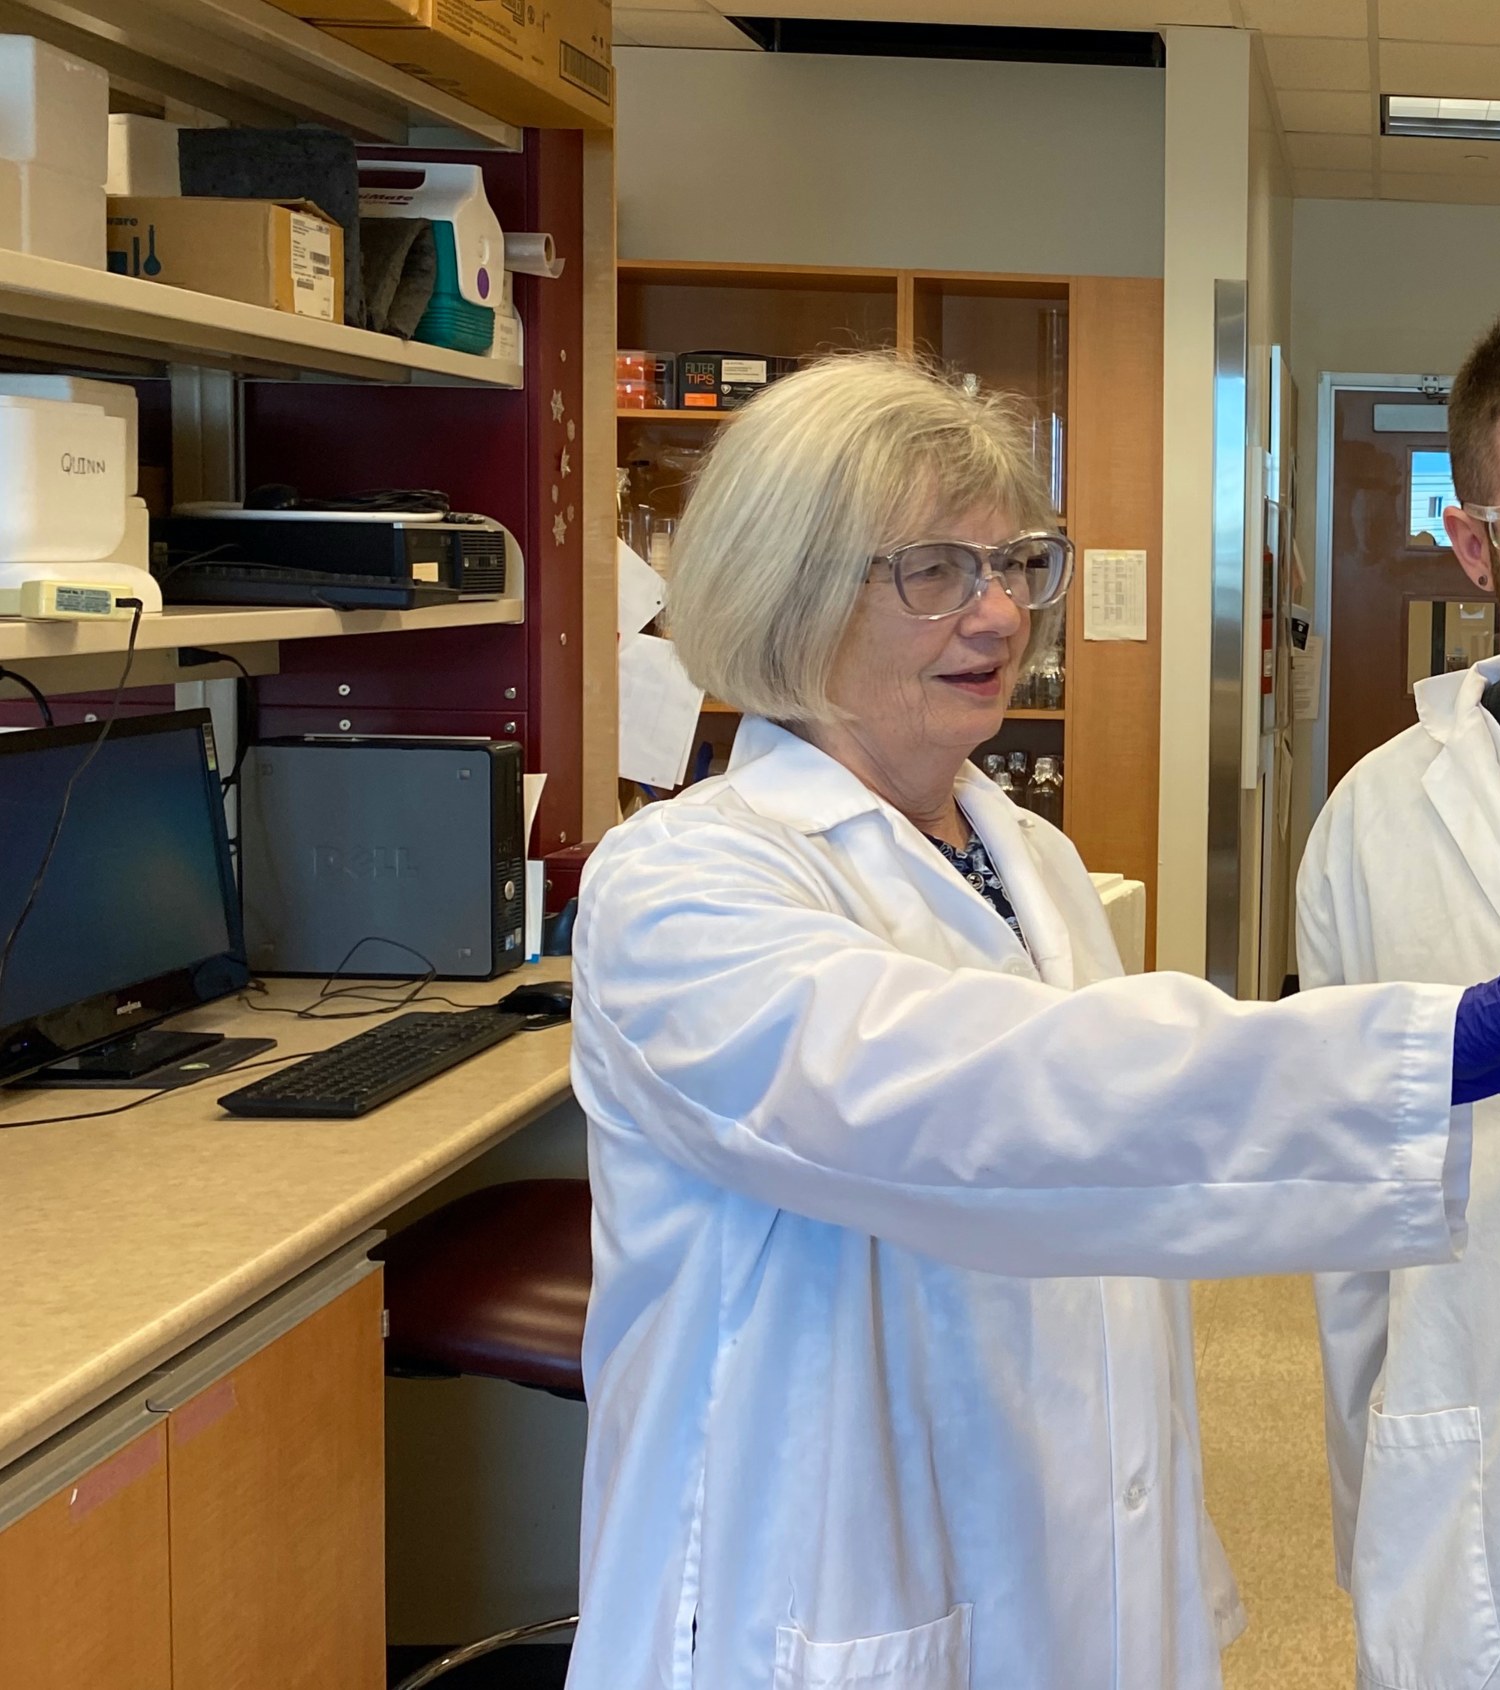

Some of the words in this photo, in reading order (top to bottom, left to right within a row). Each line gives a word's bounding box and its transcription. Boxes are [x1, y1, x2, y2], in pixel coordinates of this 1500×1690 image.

[685, 362, 715, 374] FILTER
[685, 373, 715, 385] TIPS
[61, 452, 106, 475] QUINN
